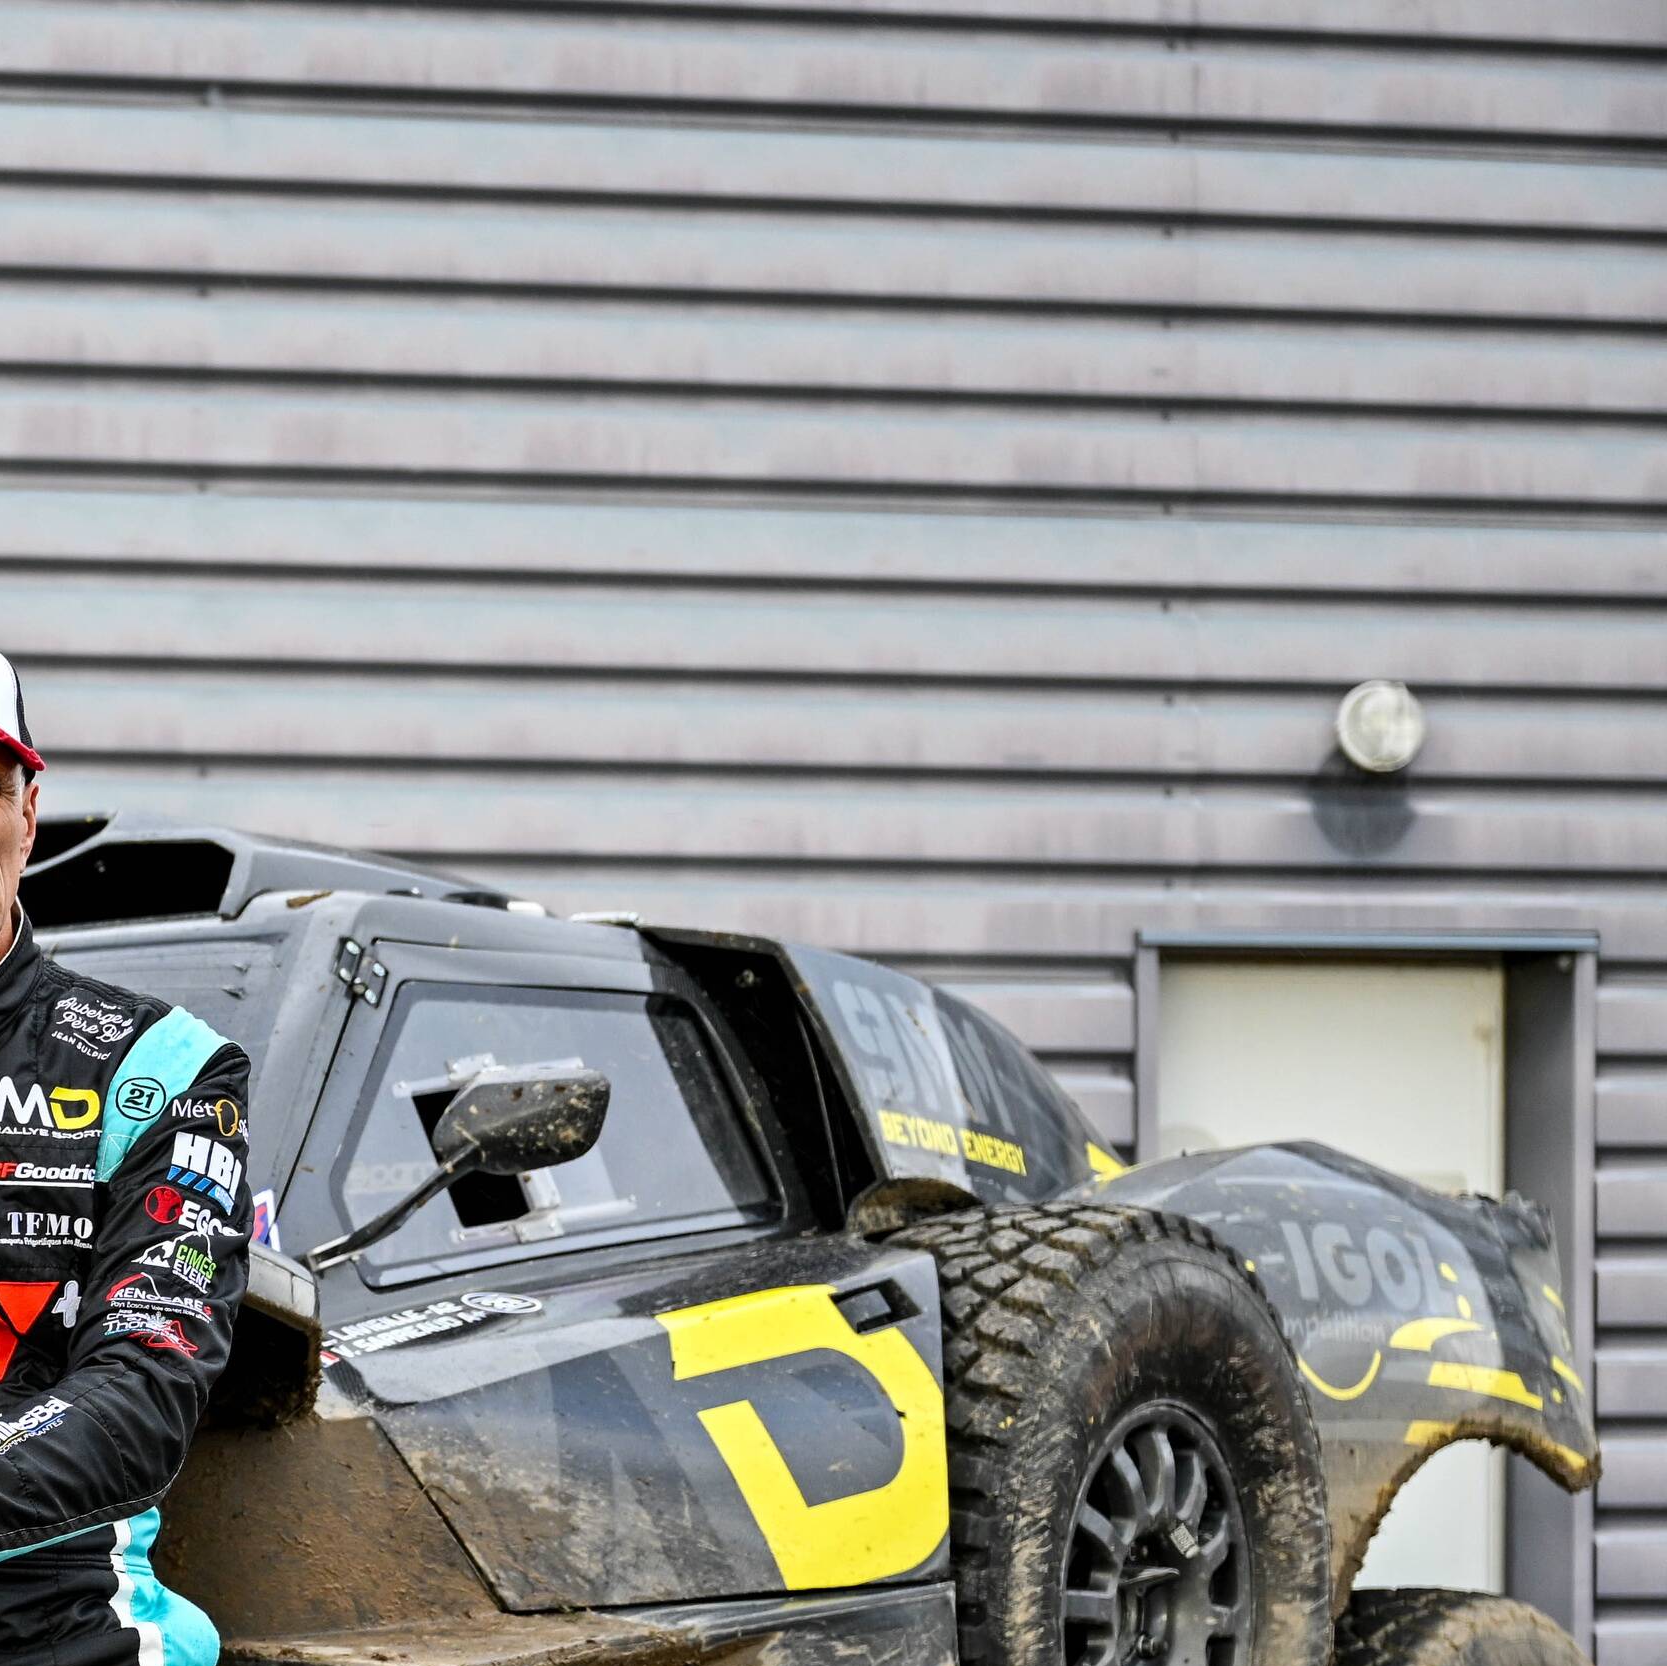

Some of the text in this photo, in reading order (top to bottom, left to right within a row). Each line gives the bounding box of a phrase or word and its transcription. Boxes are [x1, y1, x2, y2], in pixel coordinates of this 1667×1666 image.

[55, 997, 123, 1025] Auberge
[56, 1011, 99, 1034] Père
[51, 1031, 77, 1045] JEAN
[52, 1129, 103, 1140] SPORT
[878, 1110, 1028, 1176] BEYOND ENERGY
[171, 1131, 242, 1200] HBI
[7, 1211, 93, 1239] TFMO
[173, 1259, 211, 1290] EVENT
[176, 1244, 217, 1280] CIMES
[1280, 1220, 1451, 1317] IGOL
